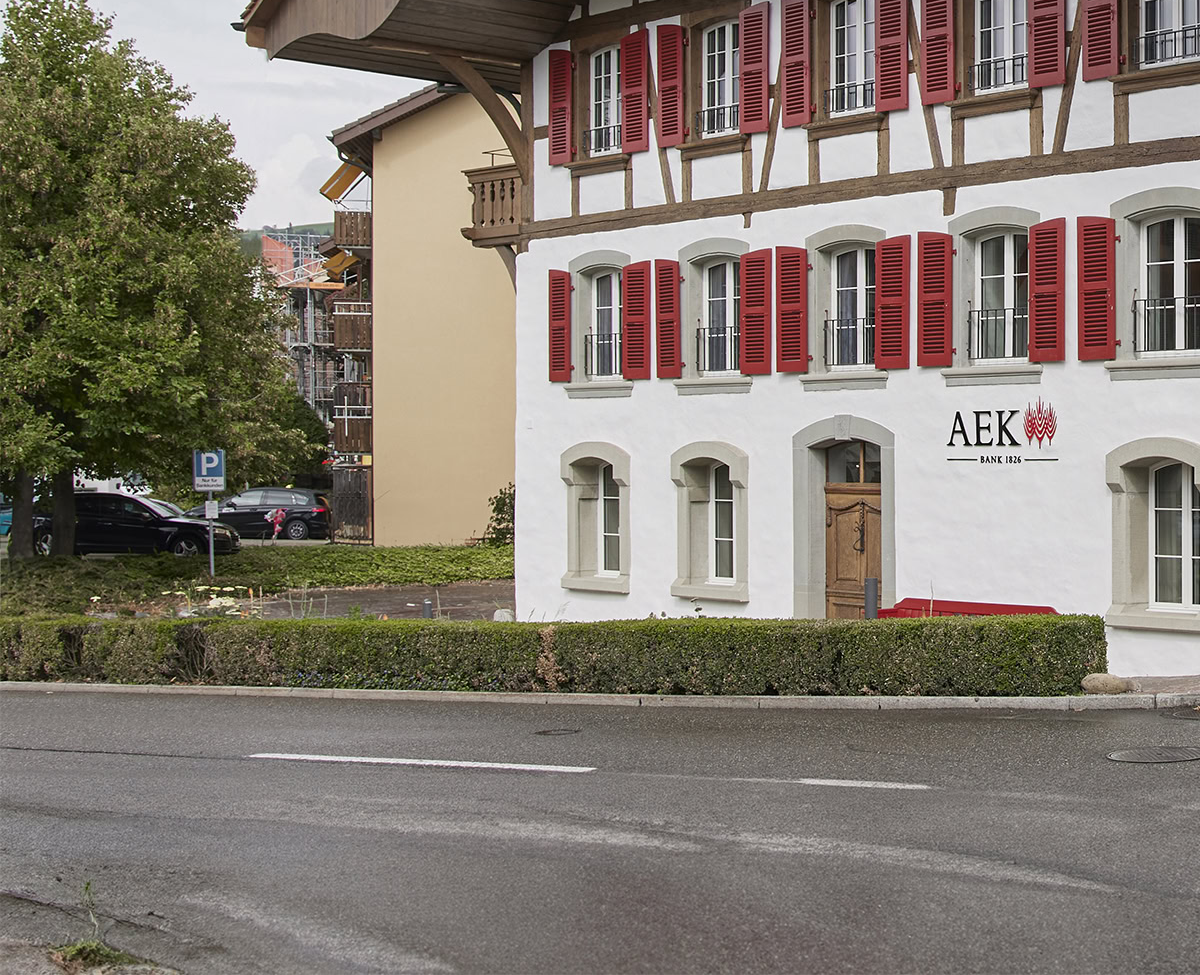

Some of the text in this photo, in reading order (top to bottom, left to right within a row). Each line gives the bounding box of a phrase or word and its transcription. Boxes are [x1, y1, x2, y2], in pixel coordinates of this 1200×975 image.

[946, 410, 1022, 447] AEK
[201, 452, 219, 476] P
[980, 456, 1022, 464] BANK 1826
